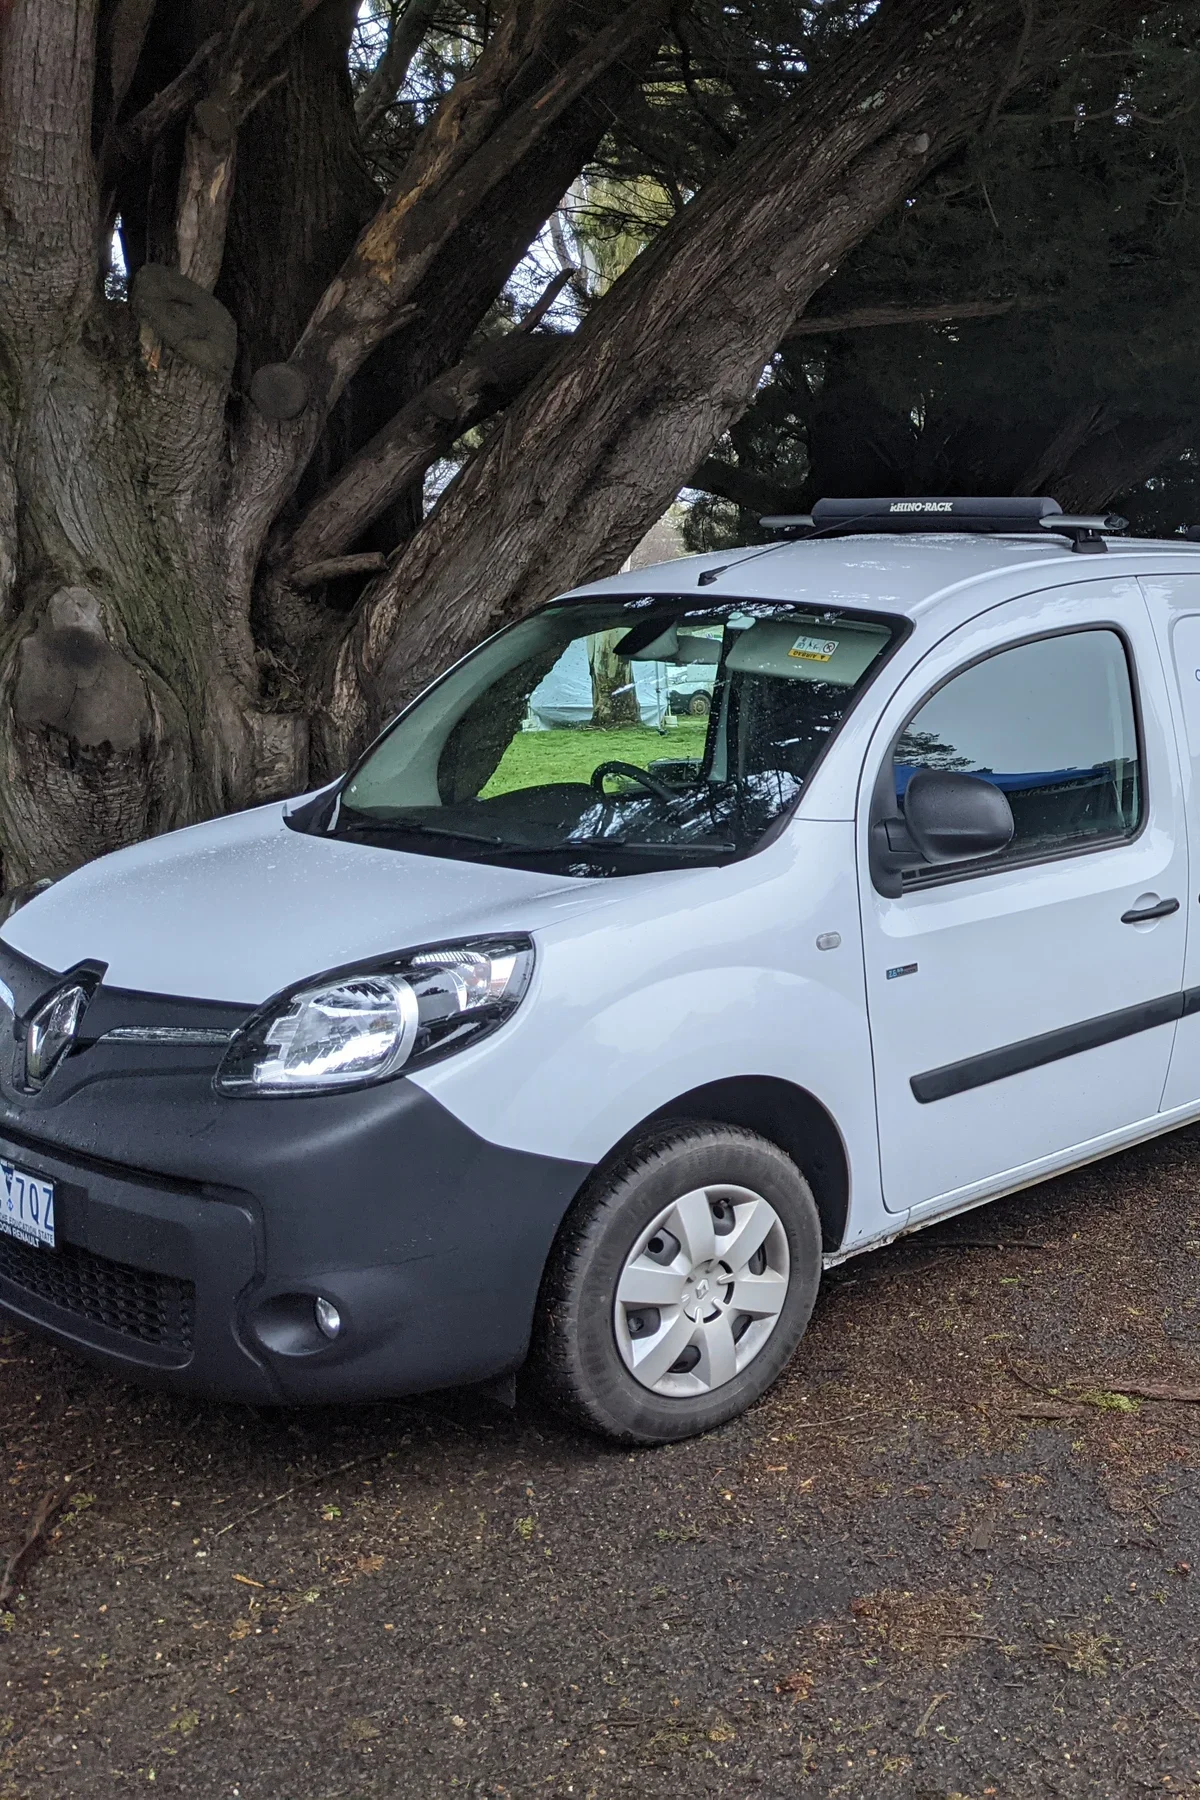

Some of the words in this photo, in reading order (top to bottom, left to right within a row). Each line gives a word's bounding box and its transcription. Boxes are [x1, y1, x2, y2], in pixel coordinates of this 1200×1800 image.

[890, 502, 953, 512] RHINO-RACK
[12, 1228, 39, 1248] RENAULT
[38, 1229, 54, 1243] STATE
